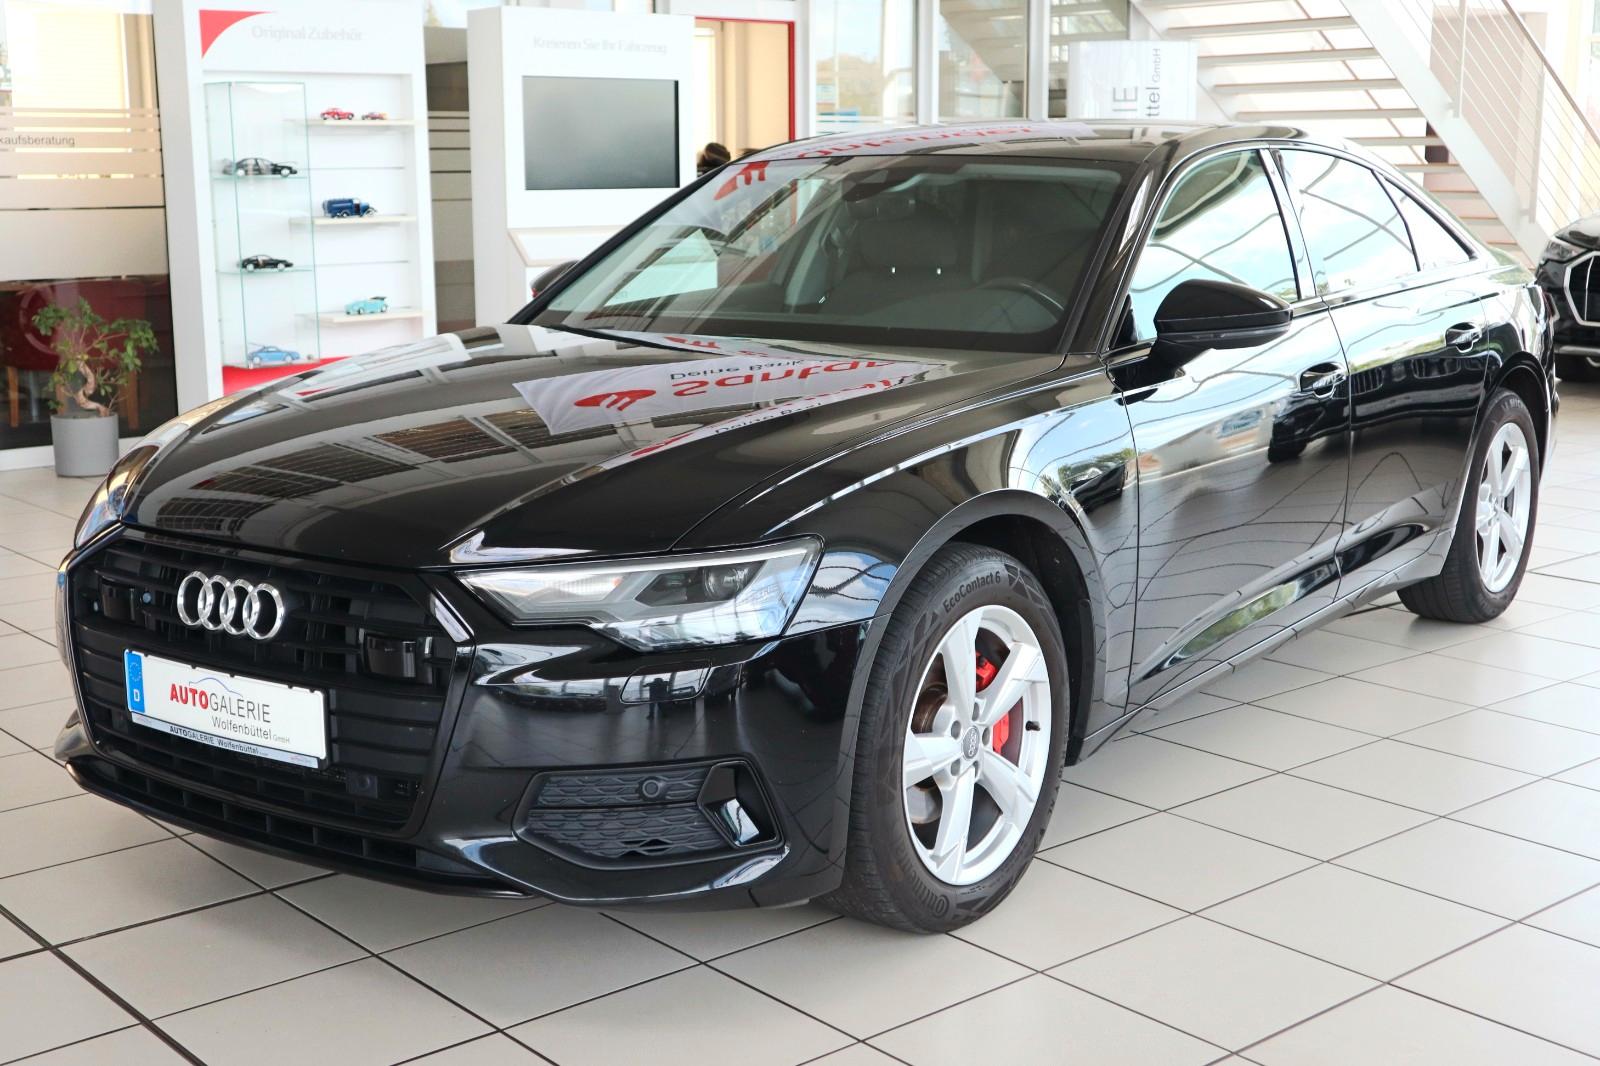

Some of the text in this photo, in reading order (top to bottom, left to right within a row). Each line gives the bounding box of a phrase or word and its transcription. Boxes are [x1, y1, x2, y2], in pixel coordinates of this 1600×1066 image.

[250, 25, 363, 42] Original Zubehör
[943, 570, 1001, 614] EcoContact 6
[133, 688, 140, 702] D
[169, 683, 271, 723] AUTOGALERIE
[169, 725, 259, 756] AUTOGALERIE Wolfenbüttel
[212, 716, 272, 740] Wolfenbüttel
